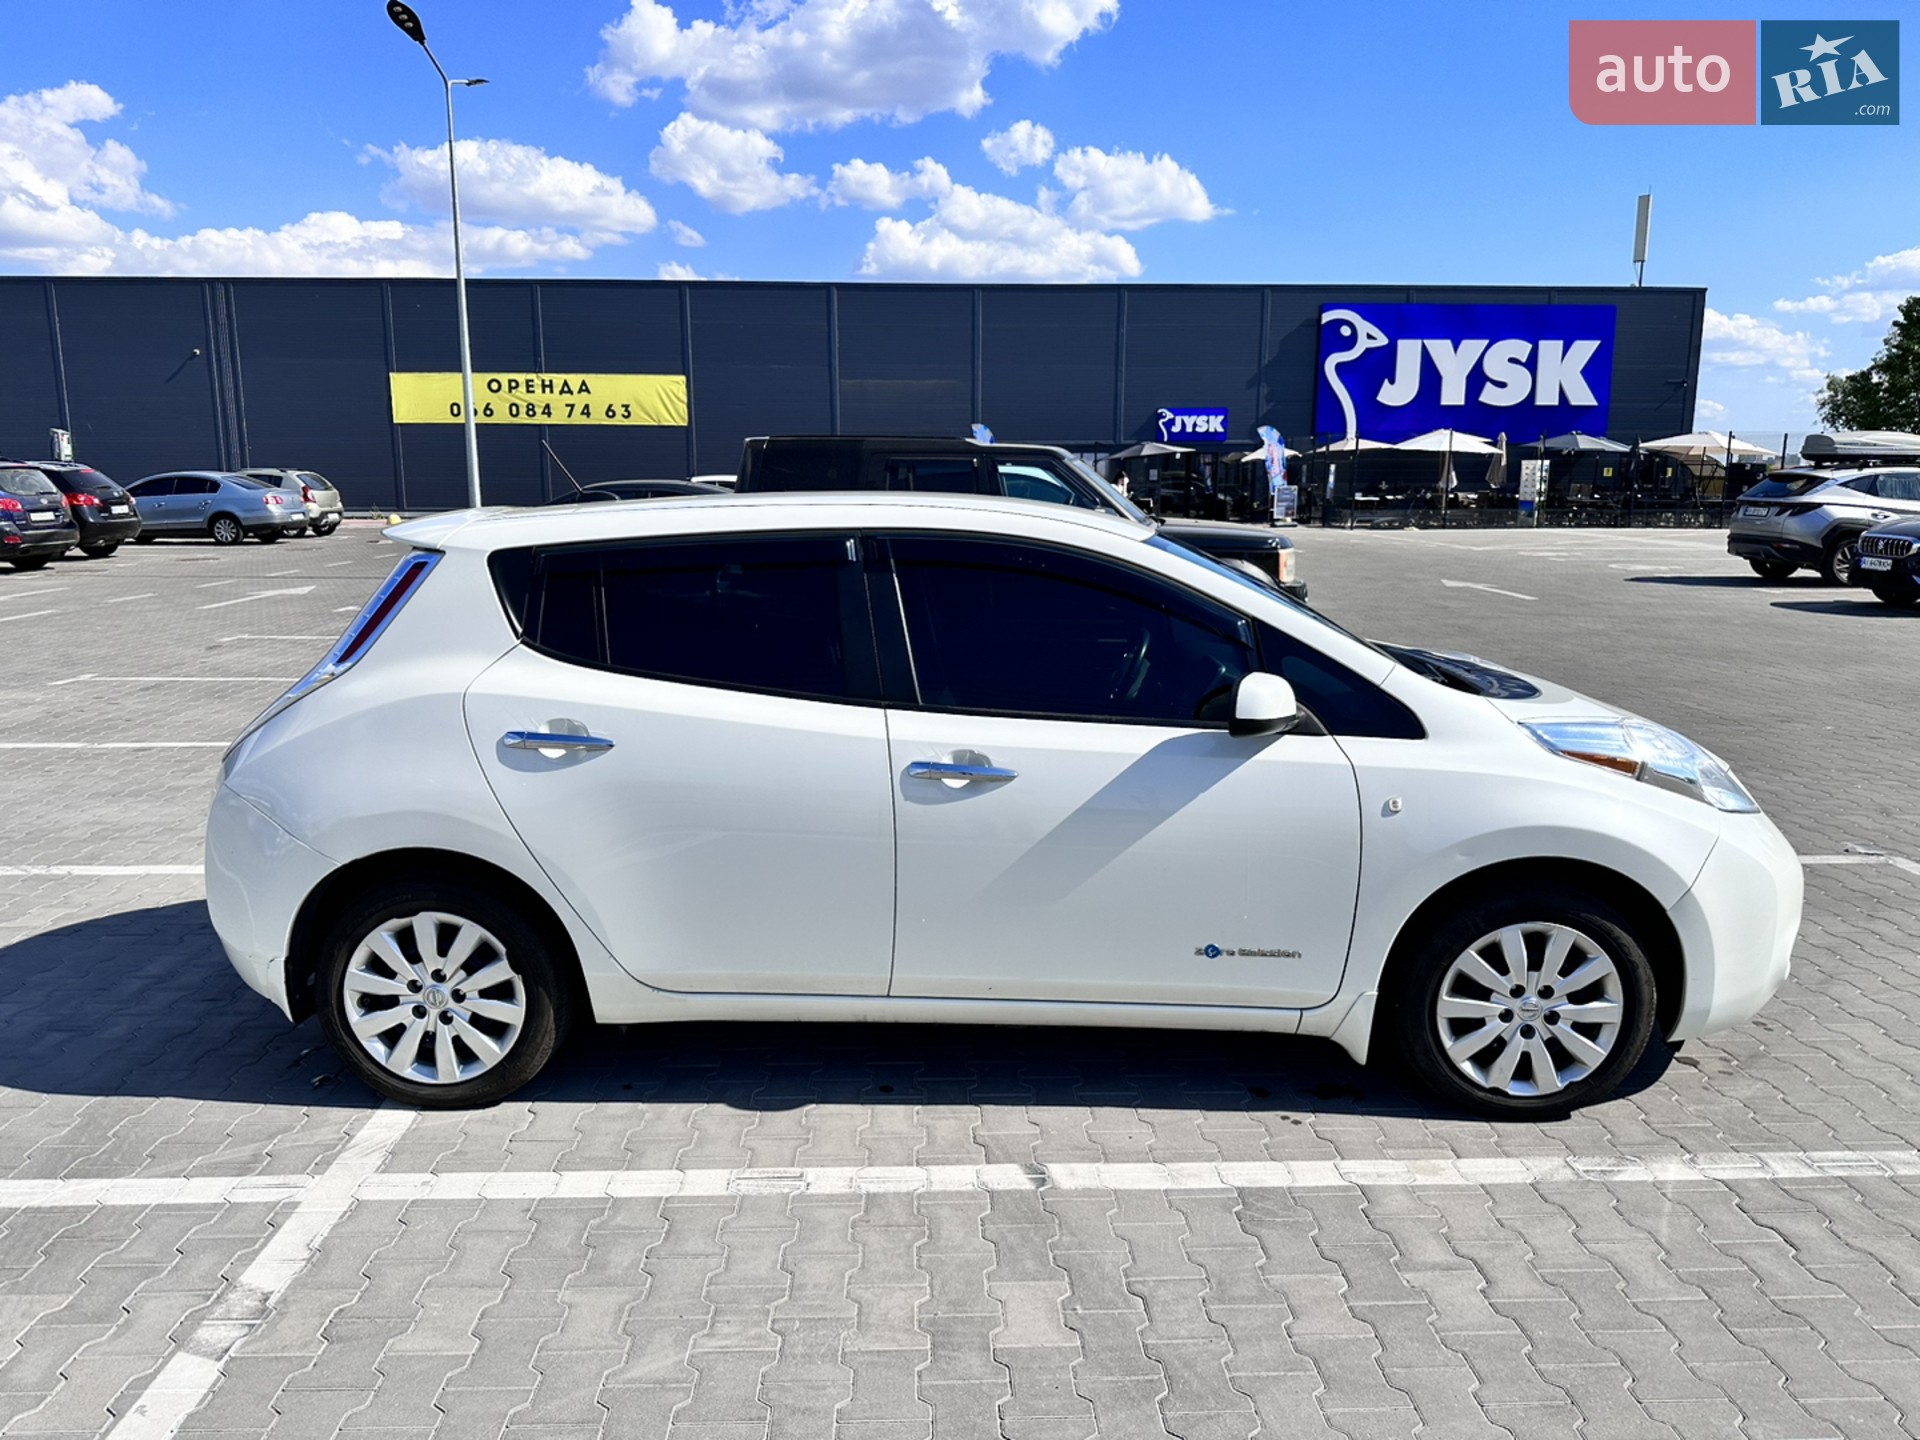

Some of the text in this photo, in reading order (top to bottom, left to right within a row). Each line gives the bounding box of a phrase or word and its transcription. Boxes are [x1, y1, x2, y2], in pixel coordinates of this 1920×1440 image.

[1376, 339, 1601, 407] JYSK
[487, 378, 591, 395] ОРЕНДА
[508, 402, 552, 418] 084
[565, 403, 591, 418] 74
[605, 404, 632, 418] 63
[1170, 415, 1225, 433] JYSK
